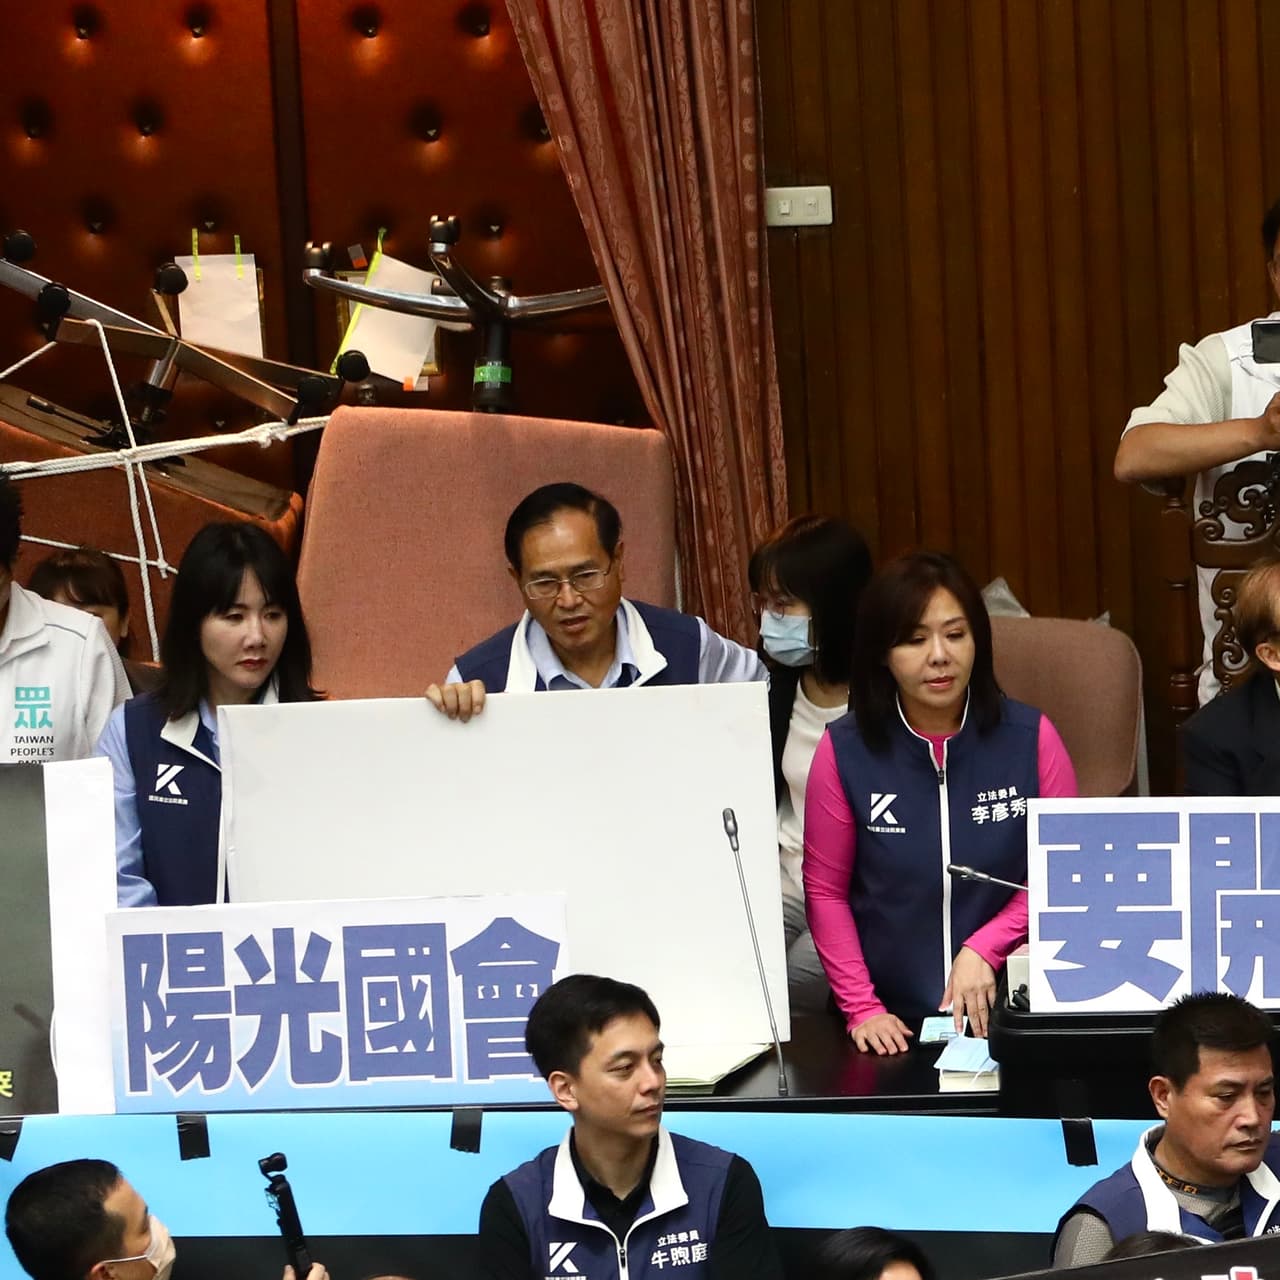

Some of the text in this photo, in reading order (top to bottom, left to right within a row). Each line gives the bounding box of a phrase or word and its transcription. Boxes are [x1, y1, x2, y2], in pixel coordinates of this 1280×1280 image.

[14, 735, 54, 746] TAIWAN
[10, 748, 55, 760] PEOPLE'S
[977, 786, 1018, 803] 立法委員
[121, 916, 560, 1096] 陽光國會
[657, 1230, 700, 1247] 立法委員
